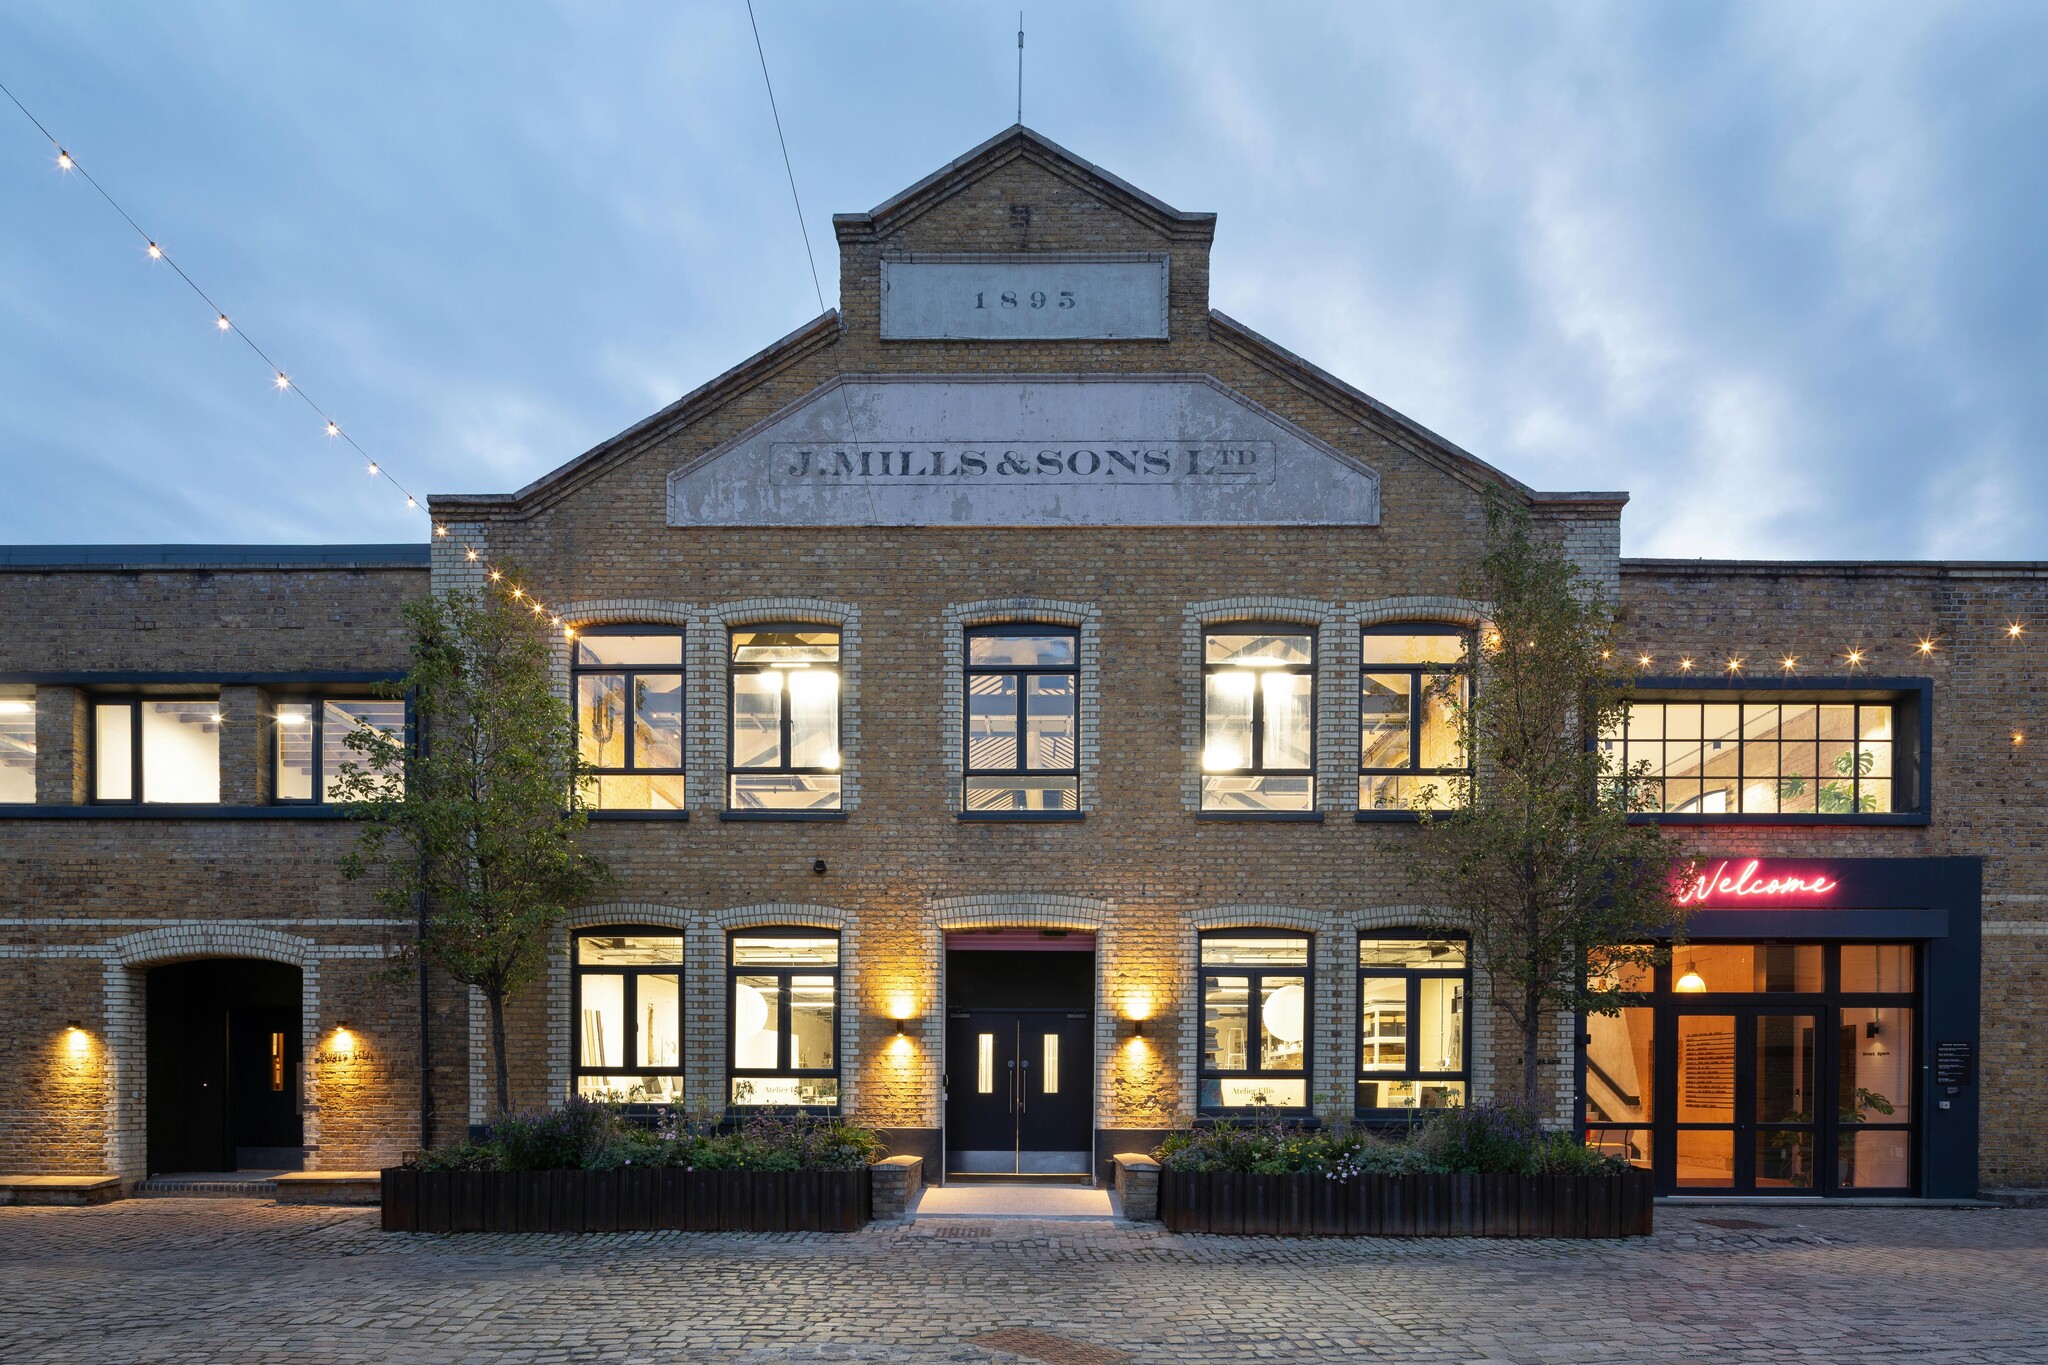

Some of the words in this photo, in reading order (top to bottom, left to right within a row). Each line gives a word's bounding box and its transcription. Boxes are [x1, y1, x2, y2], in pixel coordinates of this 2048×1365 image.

[974, 290, 1076, 310] 1895
[1679, 860, 1836, 902] Welcome
[764, 1085, 789, 1094] Atelier
[1232, 1087, 1256, 1095] Atelier
[1258, 1087, 1275, 1095] Ellis
